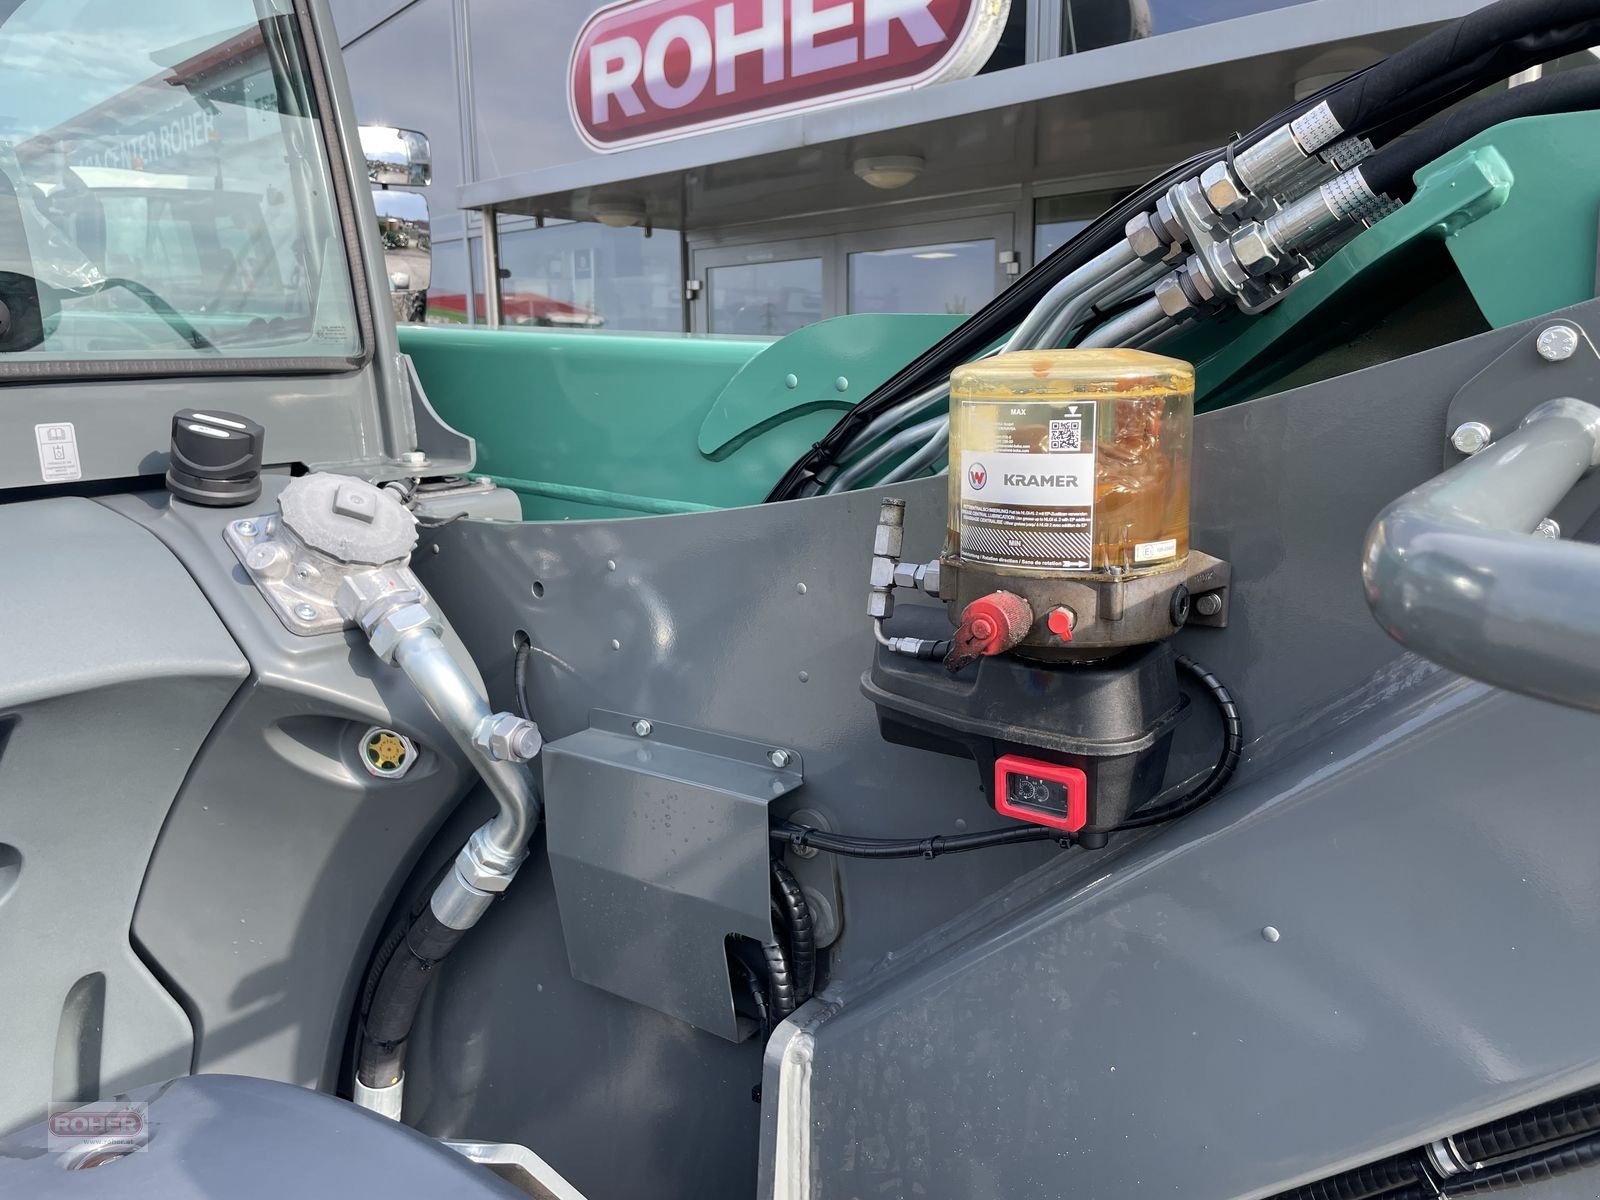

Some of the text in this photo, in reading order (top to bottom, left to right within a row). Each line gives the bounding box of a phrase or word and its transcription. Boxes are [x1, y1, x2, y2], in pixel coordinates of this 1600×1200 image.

[590, 0, 948, 125] ROHER
[1010, 408, 1027, 416] MAX
[1004, 474, 1078, 487] KRAMER
[1008, 539, 1022, 547] MIN
